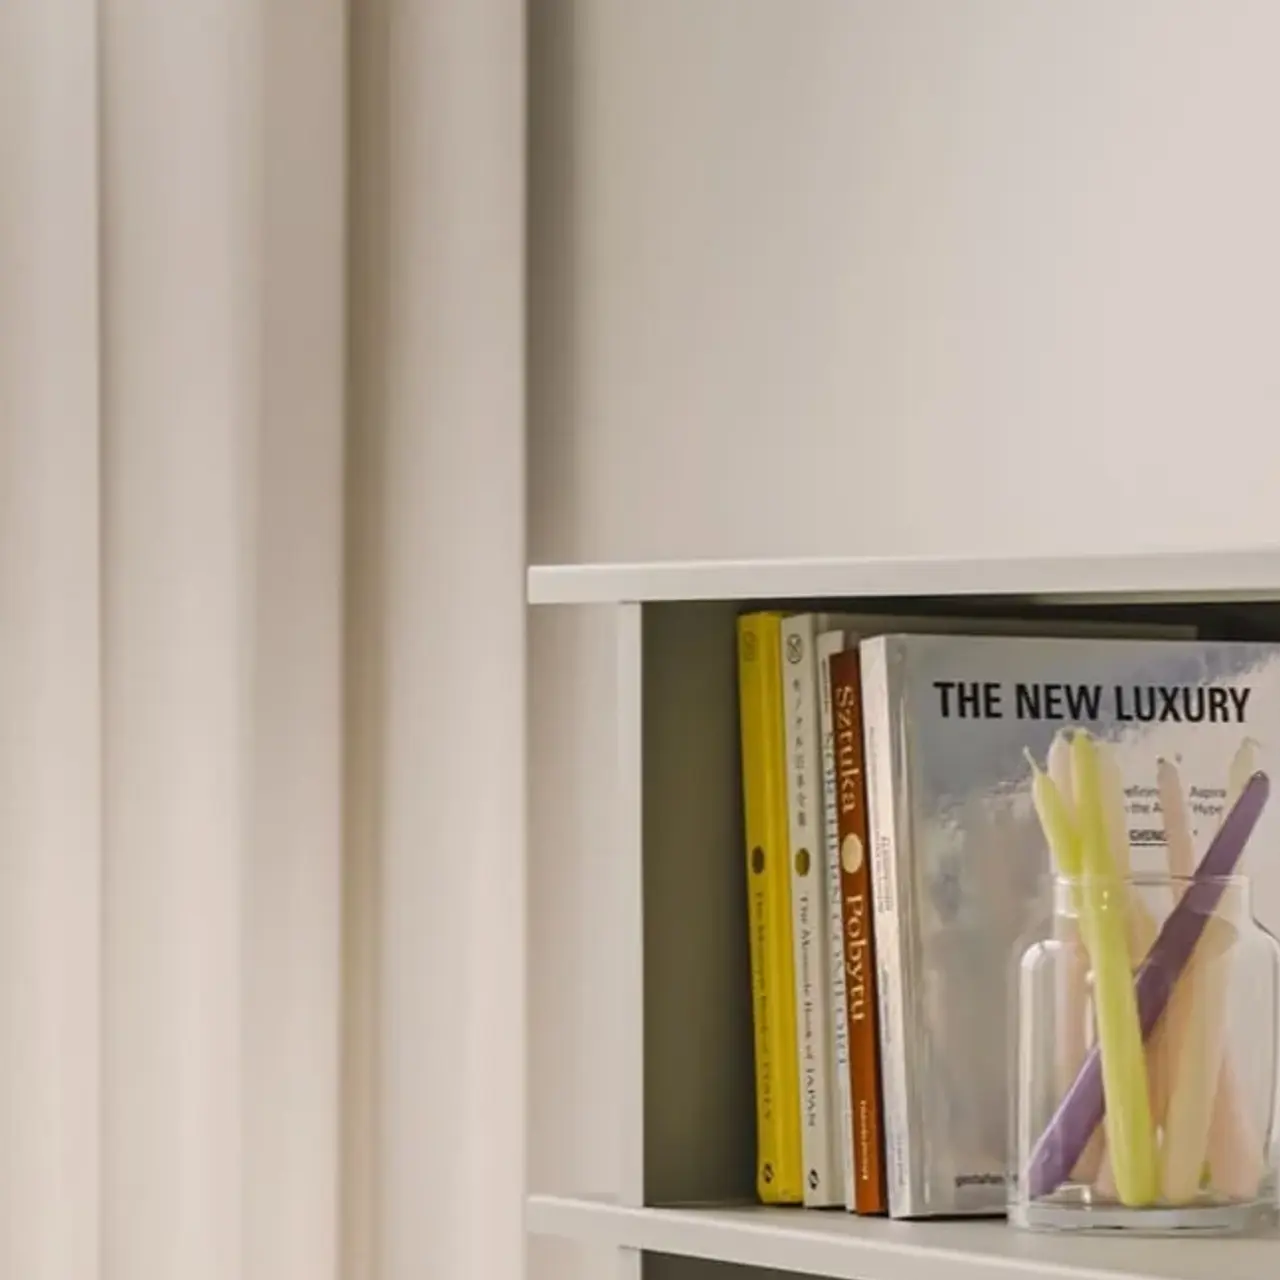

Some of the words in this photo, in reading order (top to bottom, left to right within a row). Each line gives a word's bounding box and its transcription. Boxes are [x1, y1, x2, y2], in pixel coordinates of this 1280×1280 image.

[835, 685, 861, 813] Sztuka
[933, 681, 1003, 719] THE
[1015, 683, 1101, 722] NEW
[1113, 685, 1252, 723] LUXURY
[846, 894, 868, 1021] Pobytu
[805, 1067, 817, 1128] JAPAN
